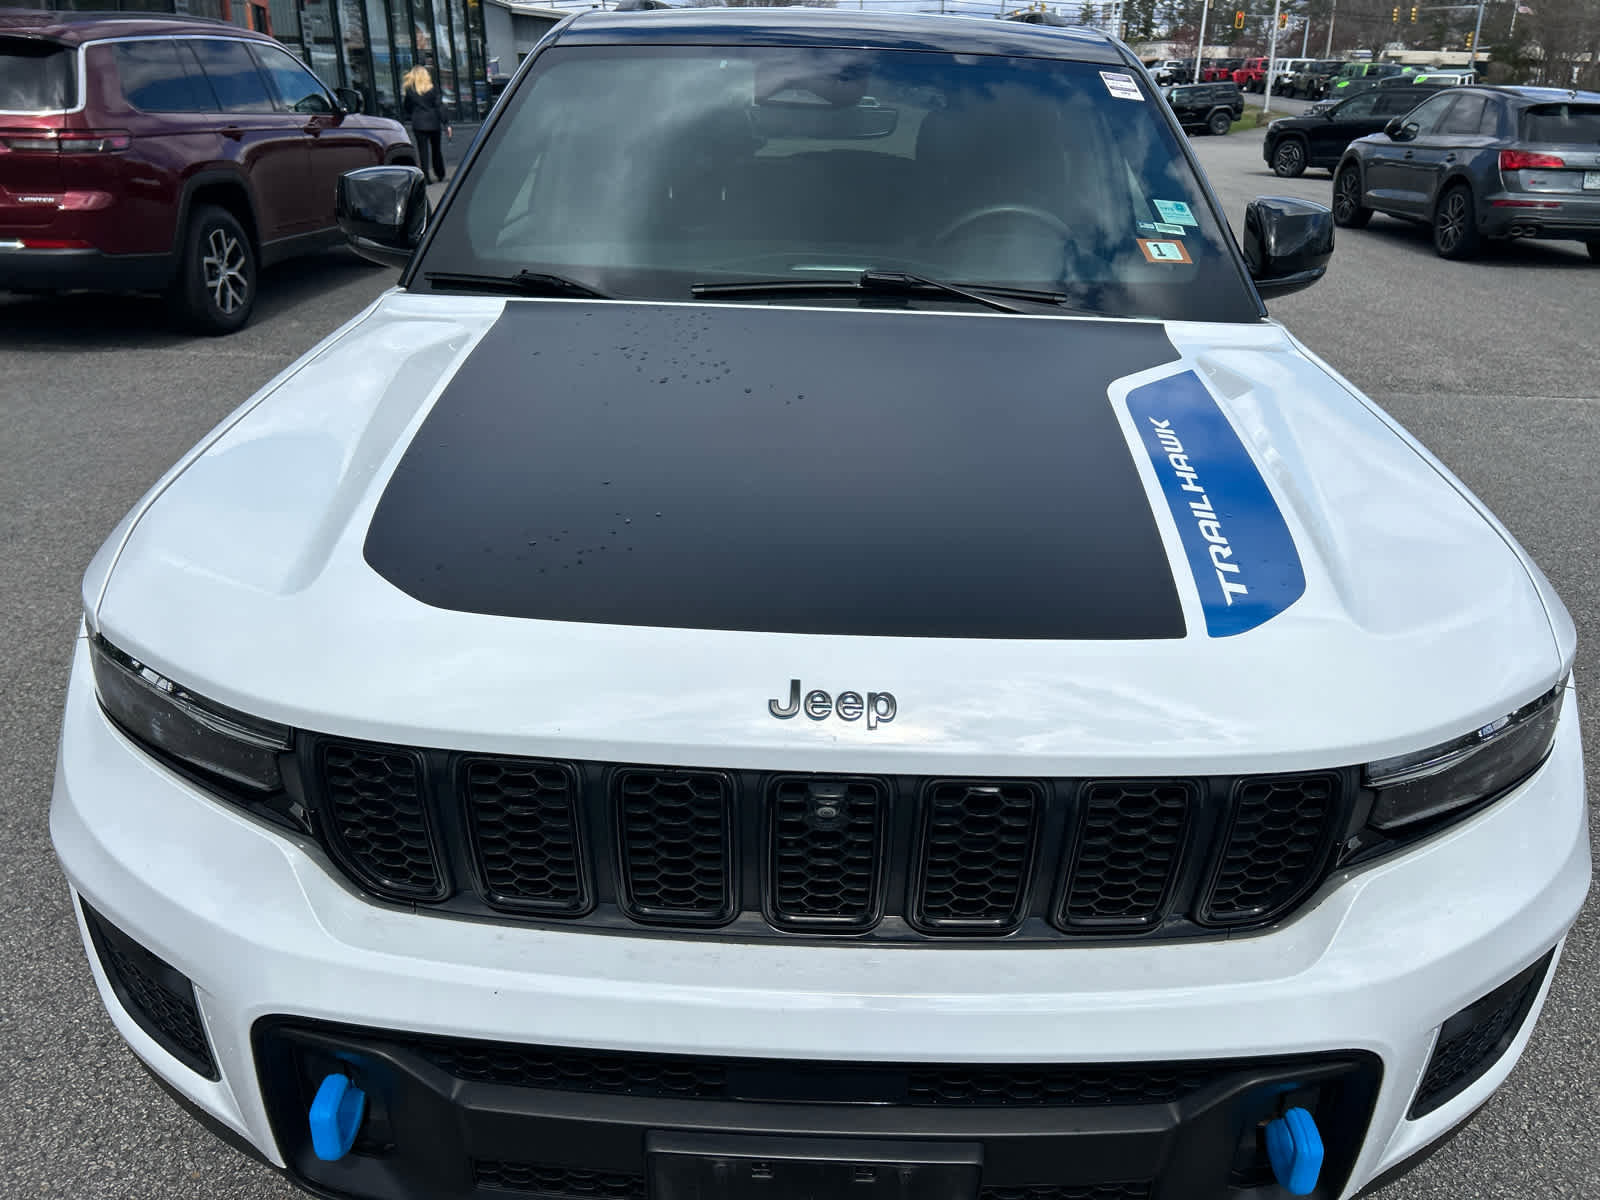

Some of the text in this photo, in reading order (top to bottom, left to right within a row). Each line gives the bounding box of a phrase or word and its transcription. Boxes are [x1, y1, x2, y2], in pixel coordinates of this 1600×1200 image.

[1152, 243, 1167, 257] 1
[1148, 416, 1249, 607] TRAILHAWK
[768, 679, 897, 730] Jeep
